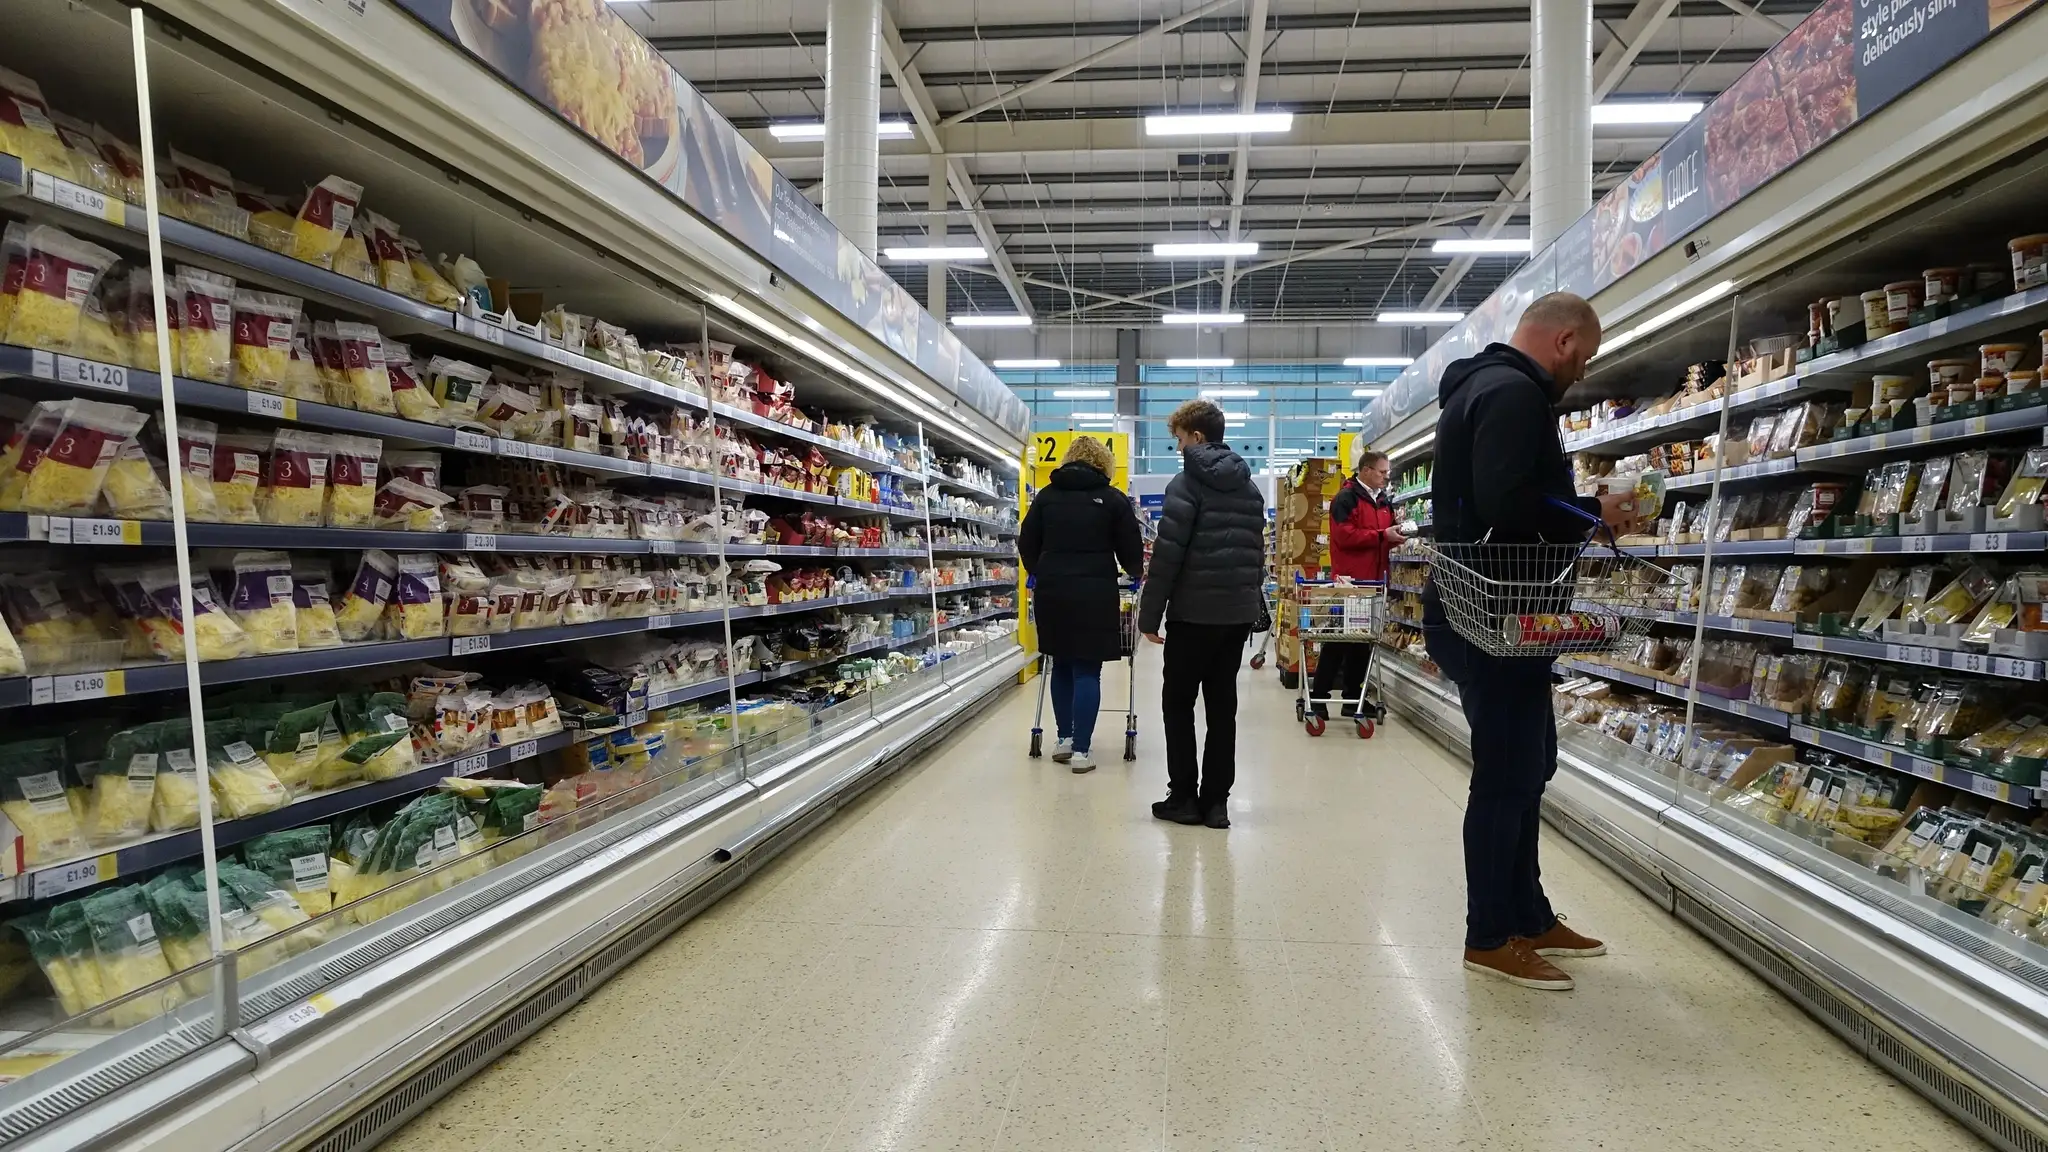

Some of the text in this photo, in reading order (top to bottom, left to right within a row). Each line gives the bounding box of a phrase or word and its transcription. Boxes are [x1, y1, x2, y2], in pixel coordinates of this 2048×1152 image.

[1861, 4, 1889, 39] style
[1862, 6, 1926, 66] deliciously
[1667, 150, 1699, 211] CHOICE
[75, 191, 104, 210] £1.90
[34, 263, 46, 283] 3
[192, 303, 202, 320] 3
[239, 322, 249, 338] 3
[348, 348, 360, 362] 3
[78, 362, 123, 387] £1.20
[261, 398, 283, 411] £1.90
[59, 437, 75, 455] 3
[468, 435, 490, 449] £2.30
[505, 443, 525, 455] £1.50
[280, 461, 293, 478] 3
[338, 464, 349, 479] 3
[92, 524, 121, 536] £1.90
[474, 535, 495, 547] £2.30
[1913, 537, 1926, 551] £3
[1985, 534, 1999, 550] £3
[405, 583, 414, 597] 4
[461, 599, 469, 611] 3
[468, 636, 489, 650] £1.50
[1920, 647, 1932, 662] £3
[1966, 655, 1980, 671] £3
[2011, 660, 2025, 678] £3
[74, 678, 104, 692] £1.90
[517, 742, 536, 757] £2.30
[465, 756, 486, 772] £1.50
[66, 864, 97, 882] £1.90
[288, 1005, 317, 1024] £1.90
